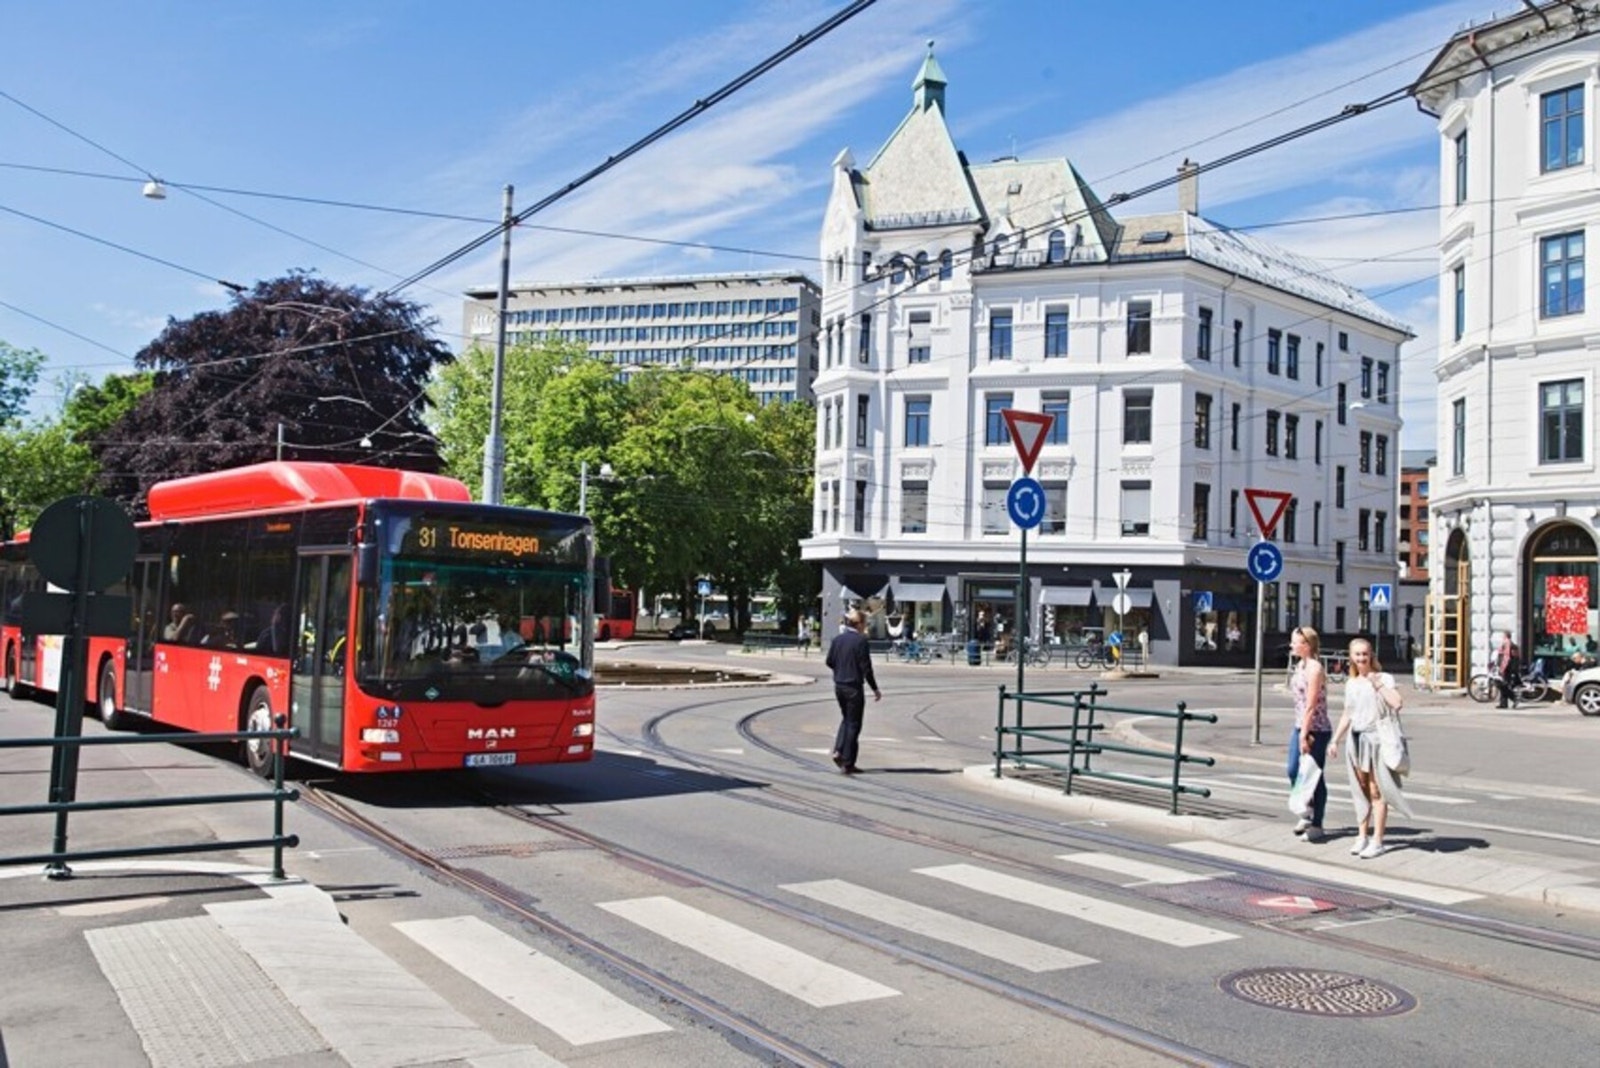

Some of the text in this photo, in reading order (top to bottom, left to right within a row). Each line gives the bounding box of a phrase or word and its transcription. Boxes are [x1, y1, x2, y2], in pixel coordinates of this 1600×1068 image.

[419, 526, 539, 556] 31 Tonsenhagen
[468, 728, 516, 739] MAN
